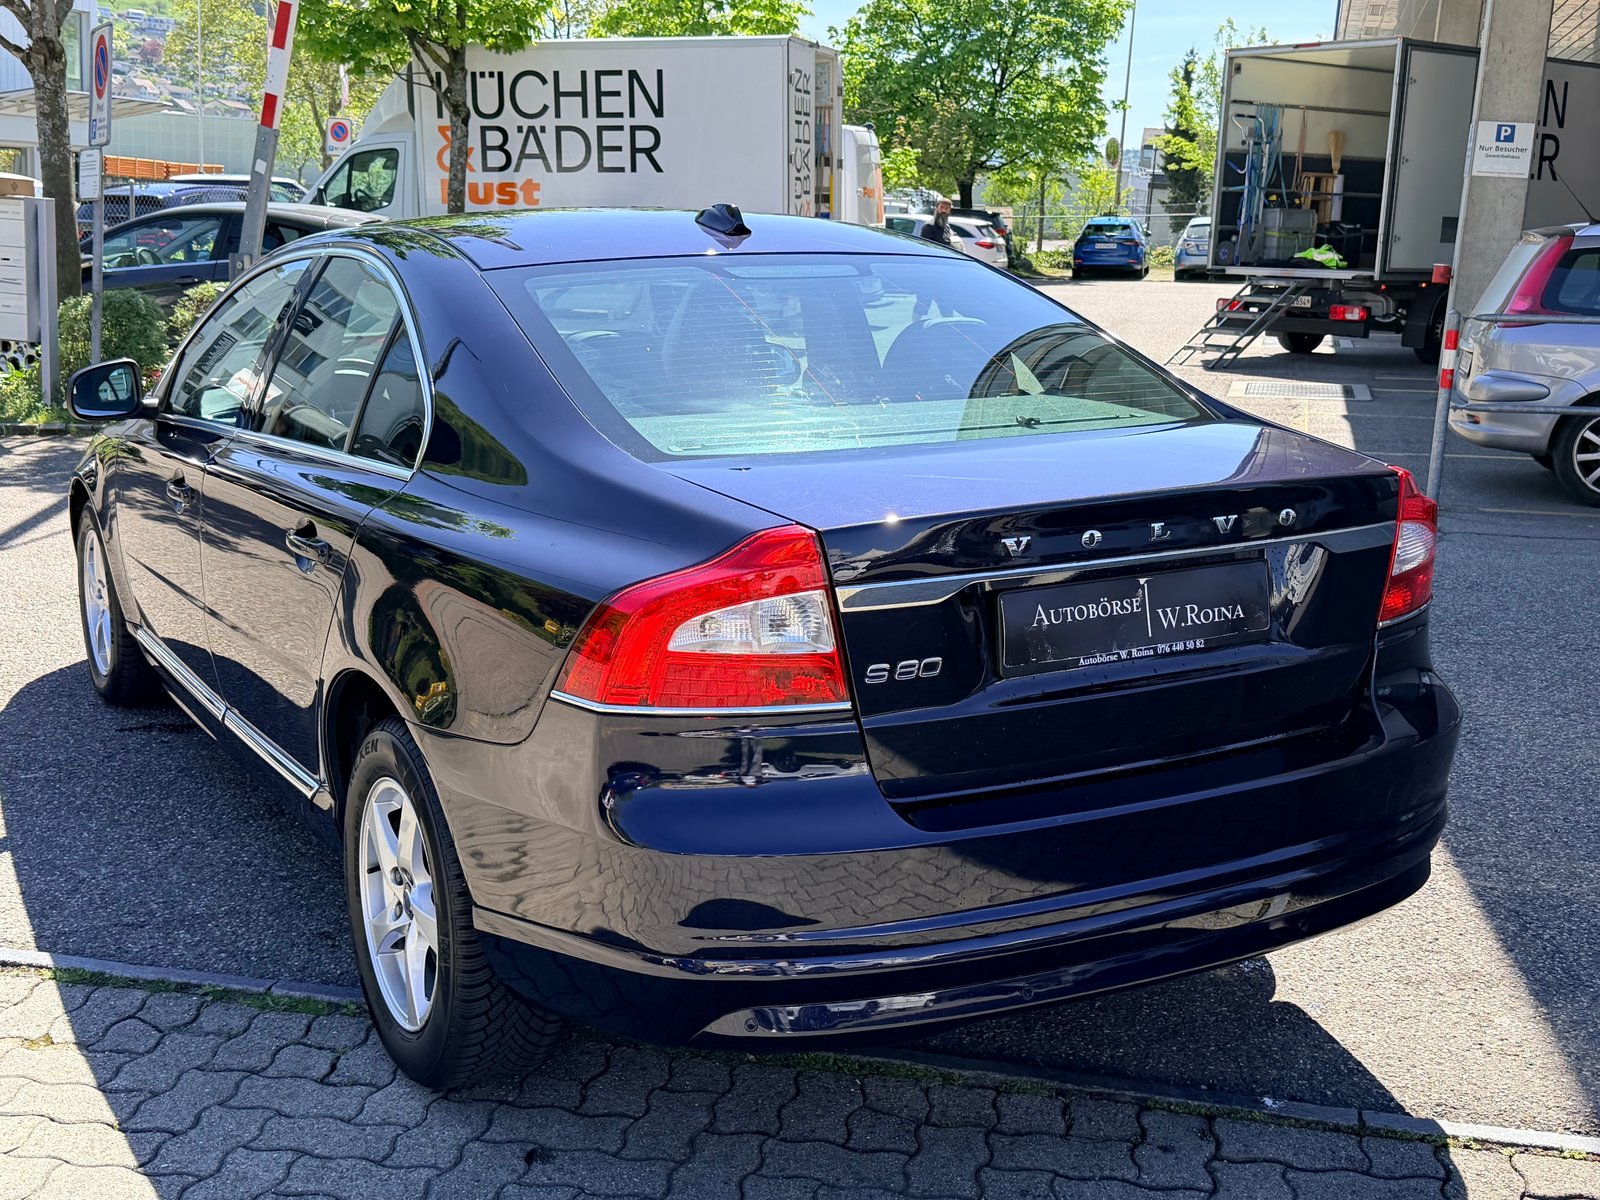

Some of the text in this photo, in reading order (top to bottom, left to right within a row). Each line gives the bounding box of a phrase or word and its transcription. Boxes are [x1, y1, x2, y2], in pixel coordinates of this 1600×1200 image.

[480, 125, 665, 173] BÄDER
[802, 72, 811, 196] BÄDER
[1495, 145, 1528, 153] Besucher
[1001, 508, 1297, 557] VOLVO
[864, 657, 942, 684] S80
[1078, 639, 1205, 666] Autobörse W. Roina 076 440 50 82
